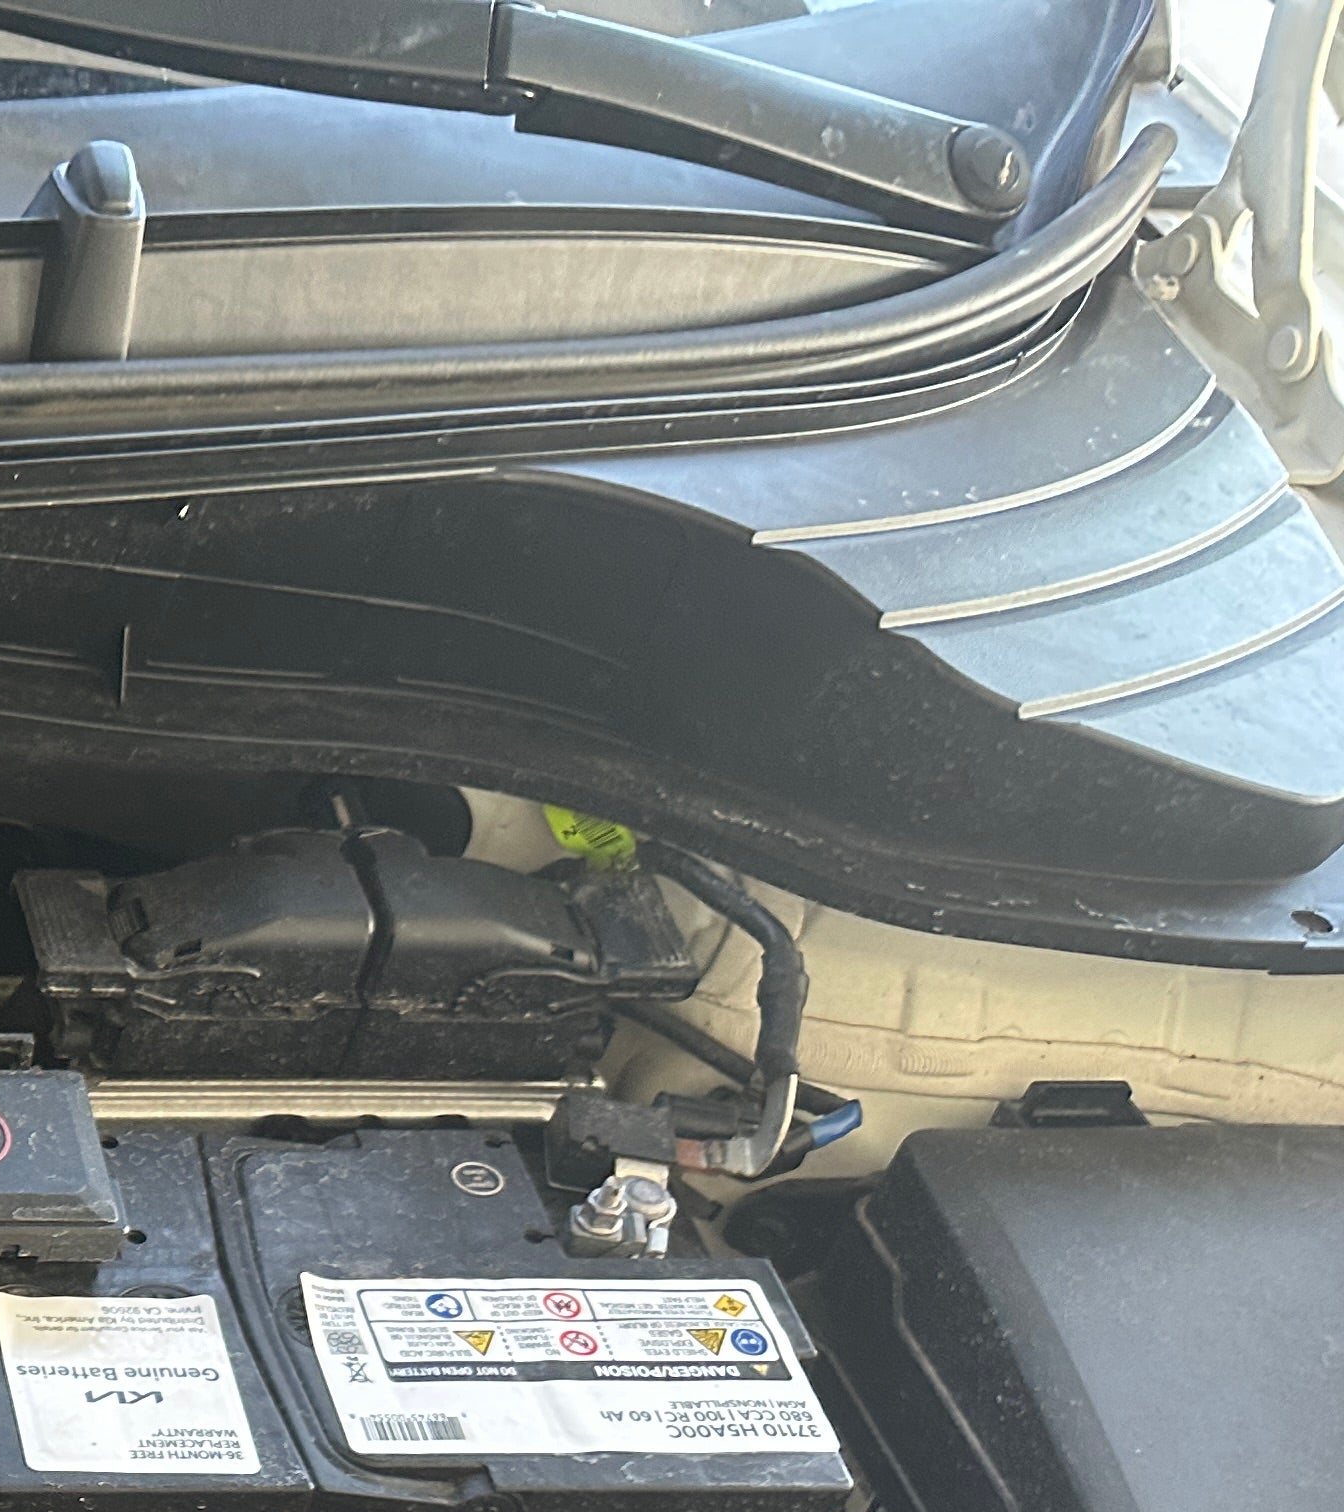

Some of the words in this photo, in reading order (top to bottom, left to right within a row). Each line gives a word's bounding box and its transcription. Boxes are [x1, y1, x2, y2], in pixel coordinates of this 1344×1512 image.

[143, 1306, 161, 1315] CA
[120, 1315, 135, 1326] by
[137, 1316, 205, 1326] Distributed
[672, 1348, 709, 1356] SHIELD
[16, 1365, 118, 1381] Batteries
[124, 1367, 220, 1382] Genuine
[441, 1366, 473, 1376] OPEN
[476, 1366, 499, 1377] NOT
[499, 1366, 518, 1377] DO
[593, 1365, 741, 1377] DANGER/POISON
[84, 1390, 164, 1405] KIA
[667, 1399, 768, 1410] NONSPILLABLE
[775, 1399, 806, 1409] AGM
[598, 1410, 624, 1423] Ah
[628, 1410, 652, 1422] 60
[663, 1411, 688, 1423] RC
[693, 1410, 726, 1422] 100
[736, 1409, 776, 1422] CCA
[778, 1410, 813, 1422] 680
[664, 1423, 759, 1439] H5A00C
[762, 1423, 822, 1438] 37110
[137, 1439, 240, 1449] REPLACEMENT
[128, 1450, 164, 1460] FREE
[167, 1449, 244, 1461] 36-MONTH
